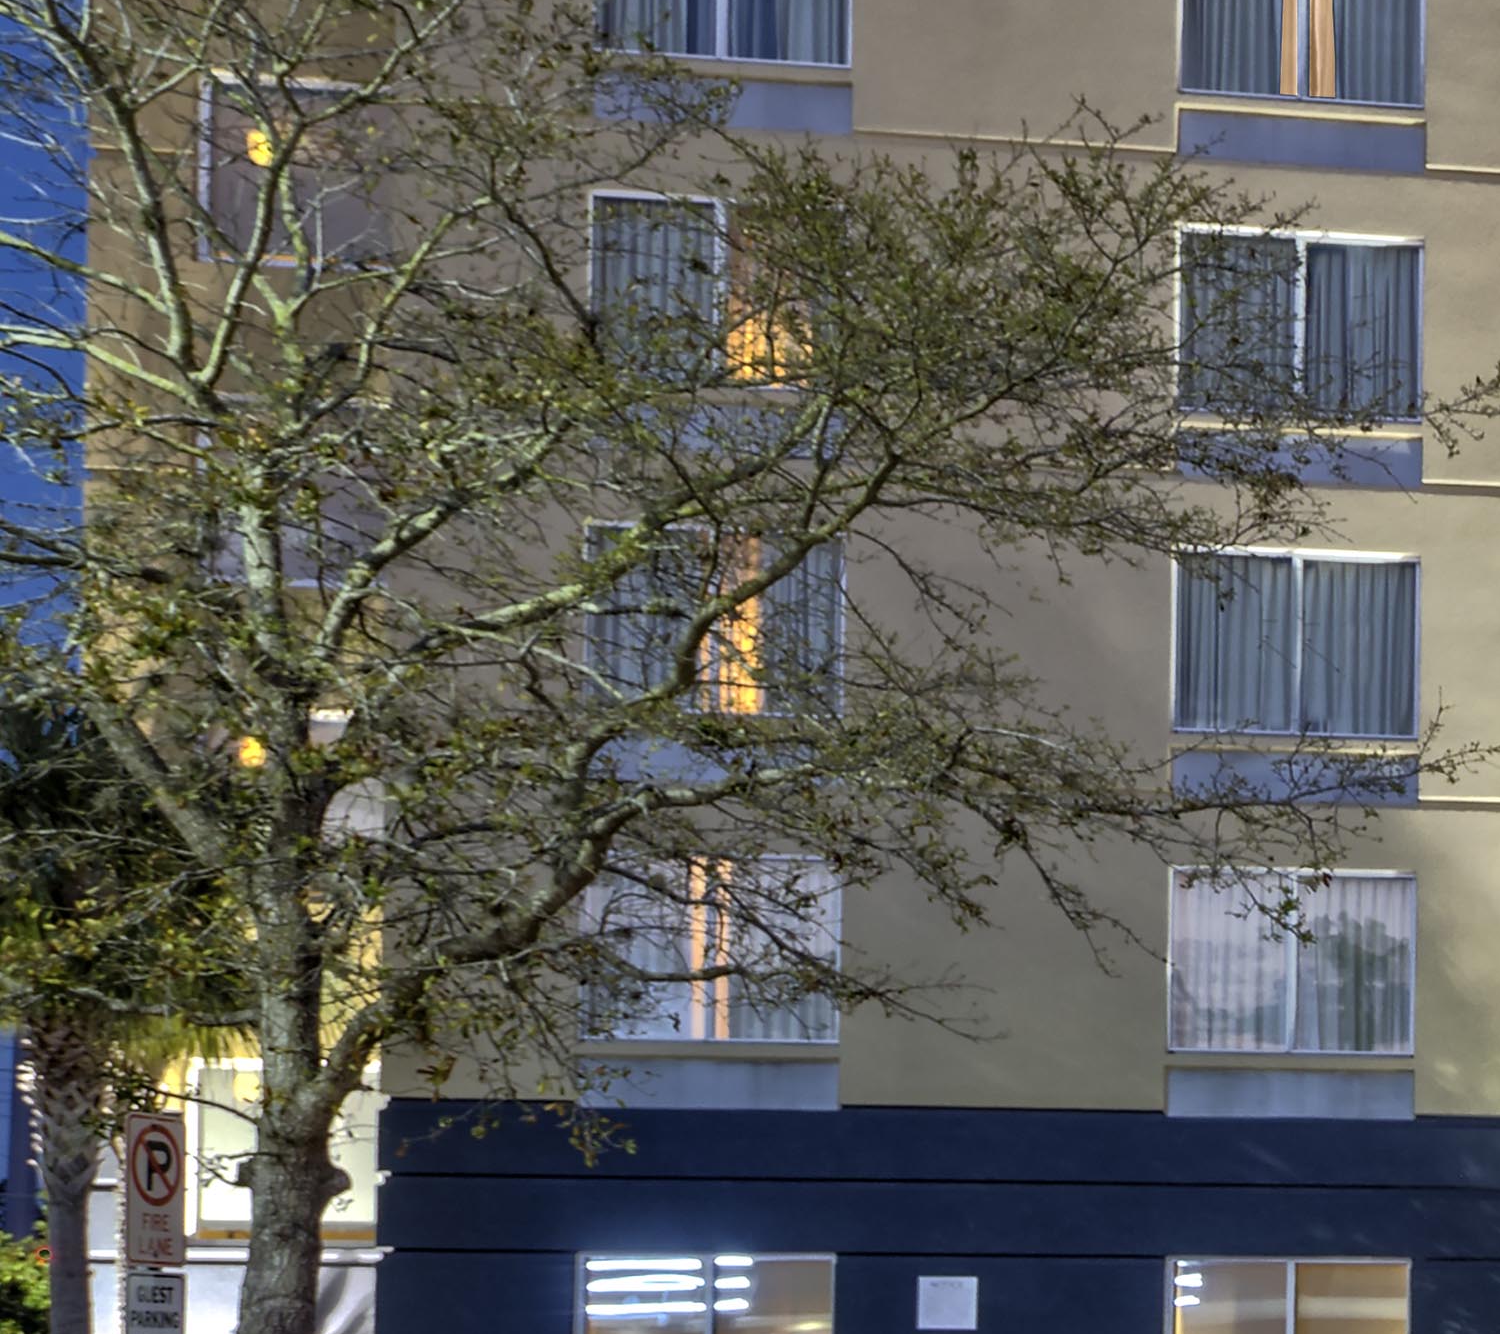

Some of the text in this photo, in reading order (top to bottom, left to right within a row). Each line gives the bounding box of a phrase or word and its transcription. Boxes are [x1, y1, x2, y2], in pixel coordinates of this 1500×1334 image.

[141, 1212, 171, 1233] FIRE
[138, 1236, 174, 1257] LANE
[136, 1285, 174, 1305] GUEST
[130, 1309, 180, 1329] PARKING
